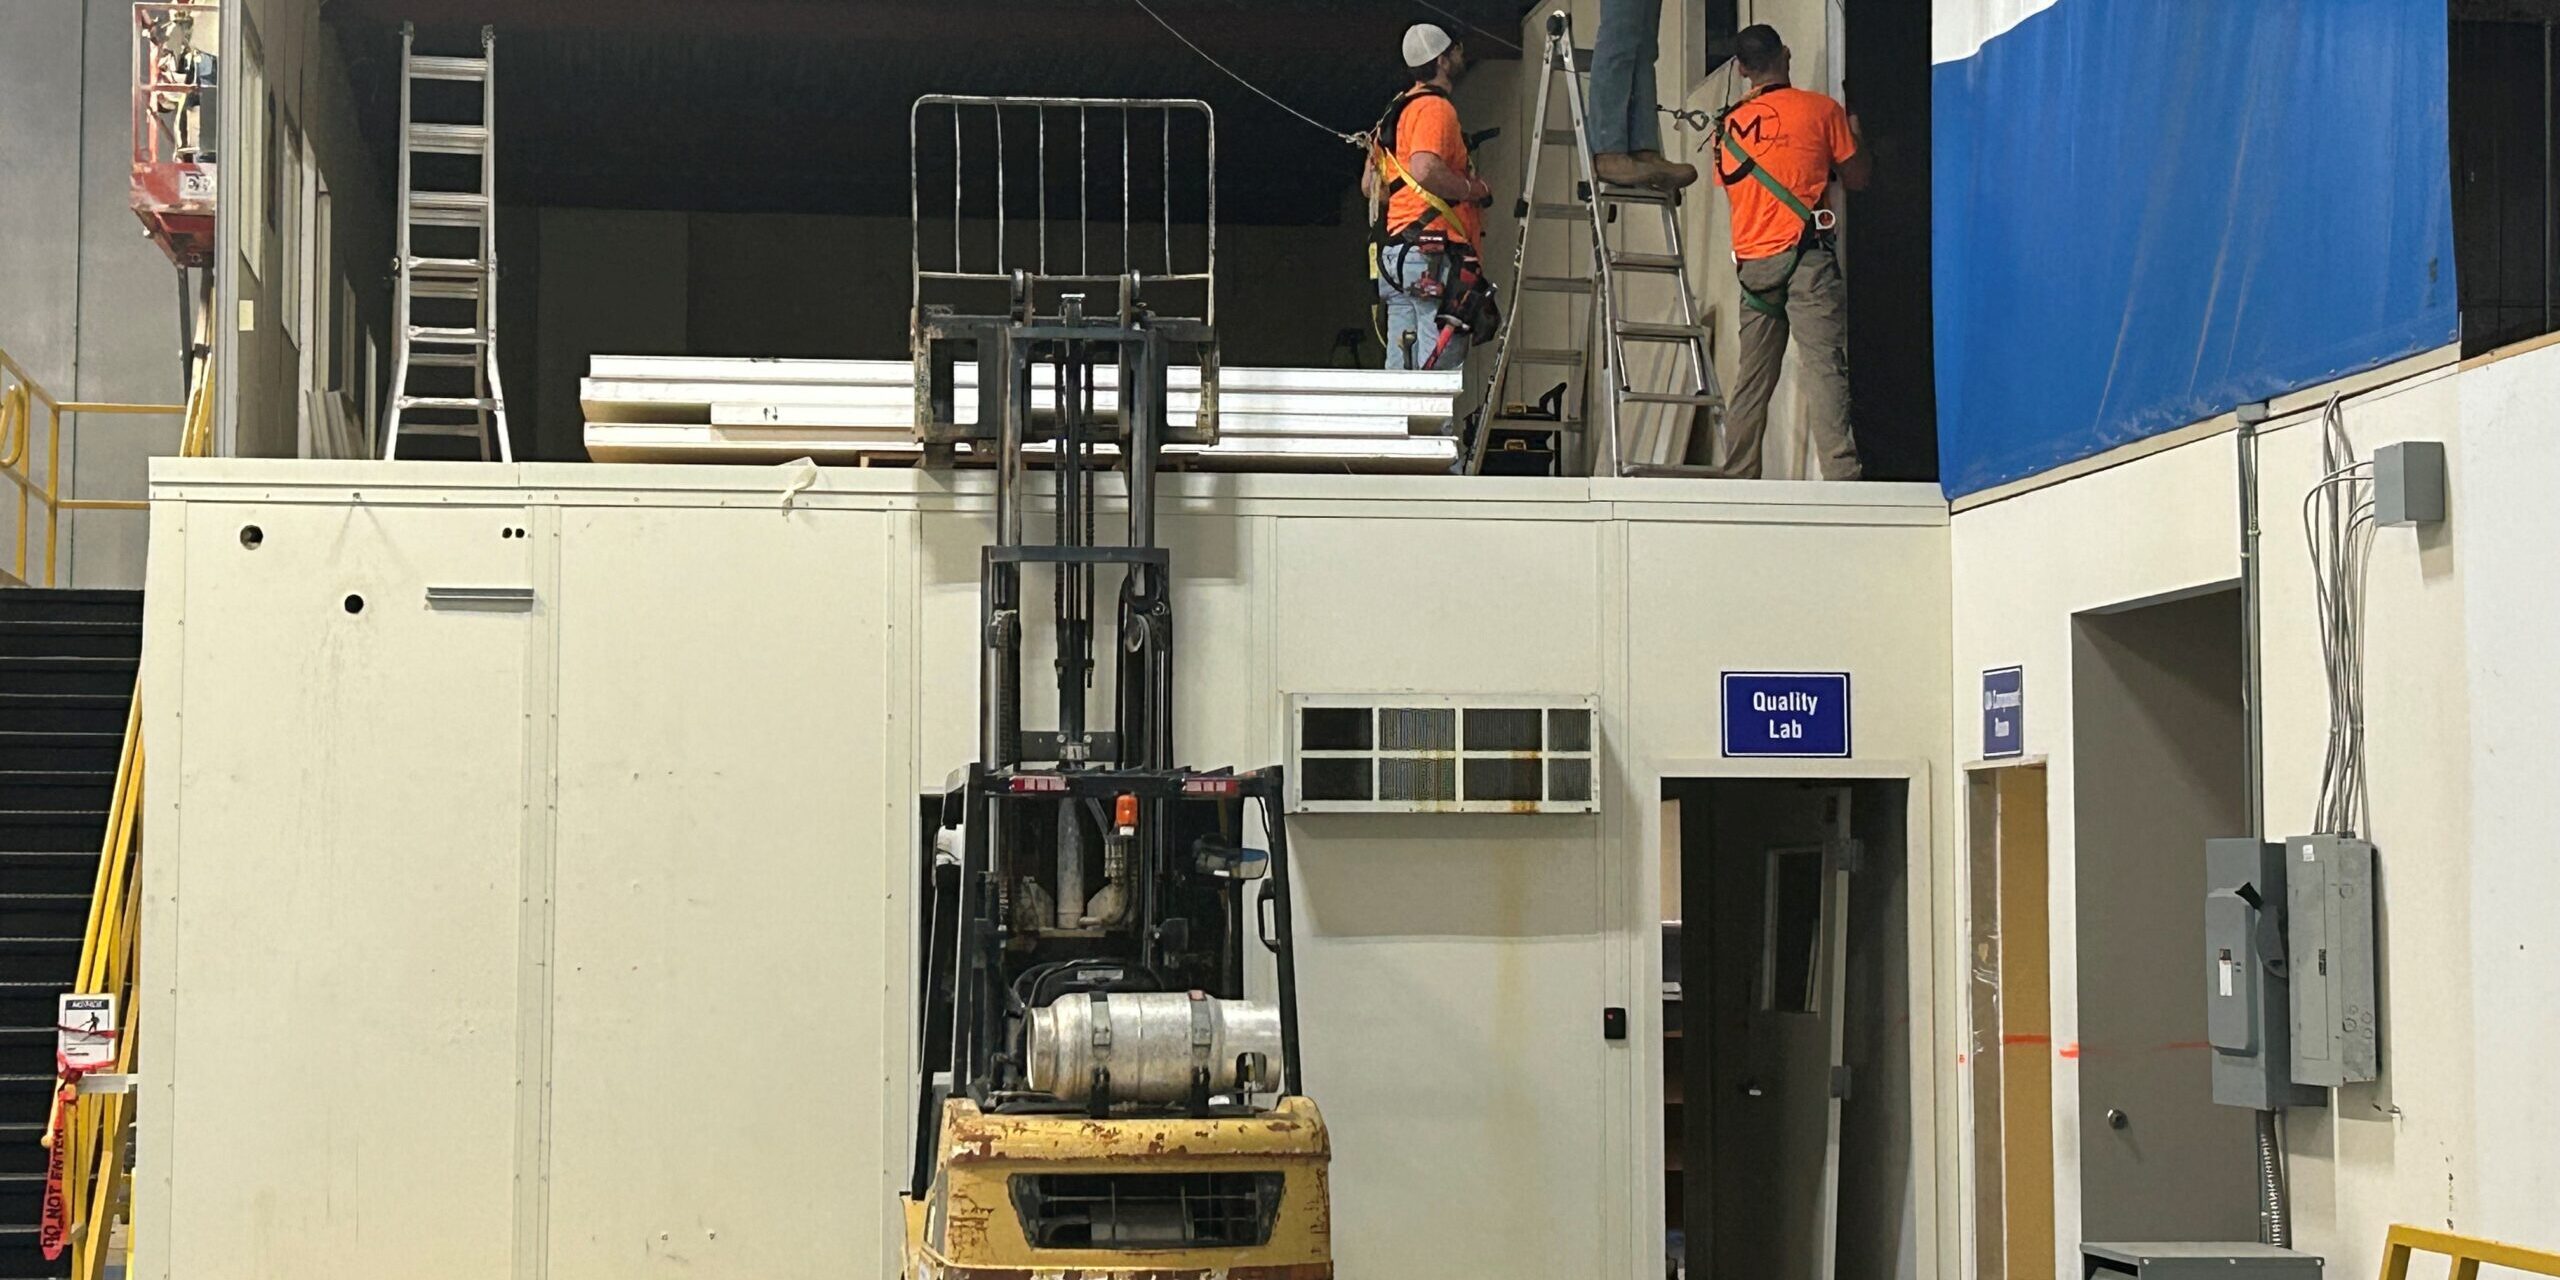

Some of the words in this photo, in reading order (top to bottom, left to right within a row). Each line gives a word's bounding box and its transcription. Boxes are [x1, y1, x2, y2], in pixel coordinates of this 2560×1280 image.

[1753, 691, 1818, 716] Quality
[1769, 719, 1802, 739] Lab
[51, 1128, 64, 1181] ENTER
[46, 1185, 61, 1219] NOT
[42, 1225, 58, 1248] DO
